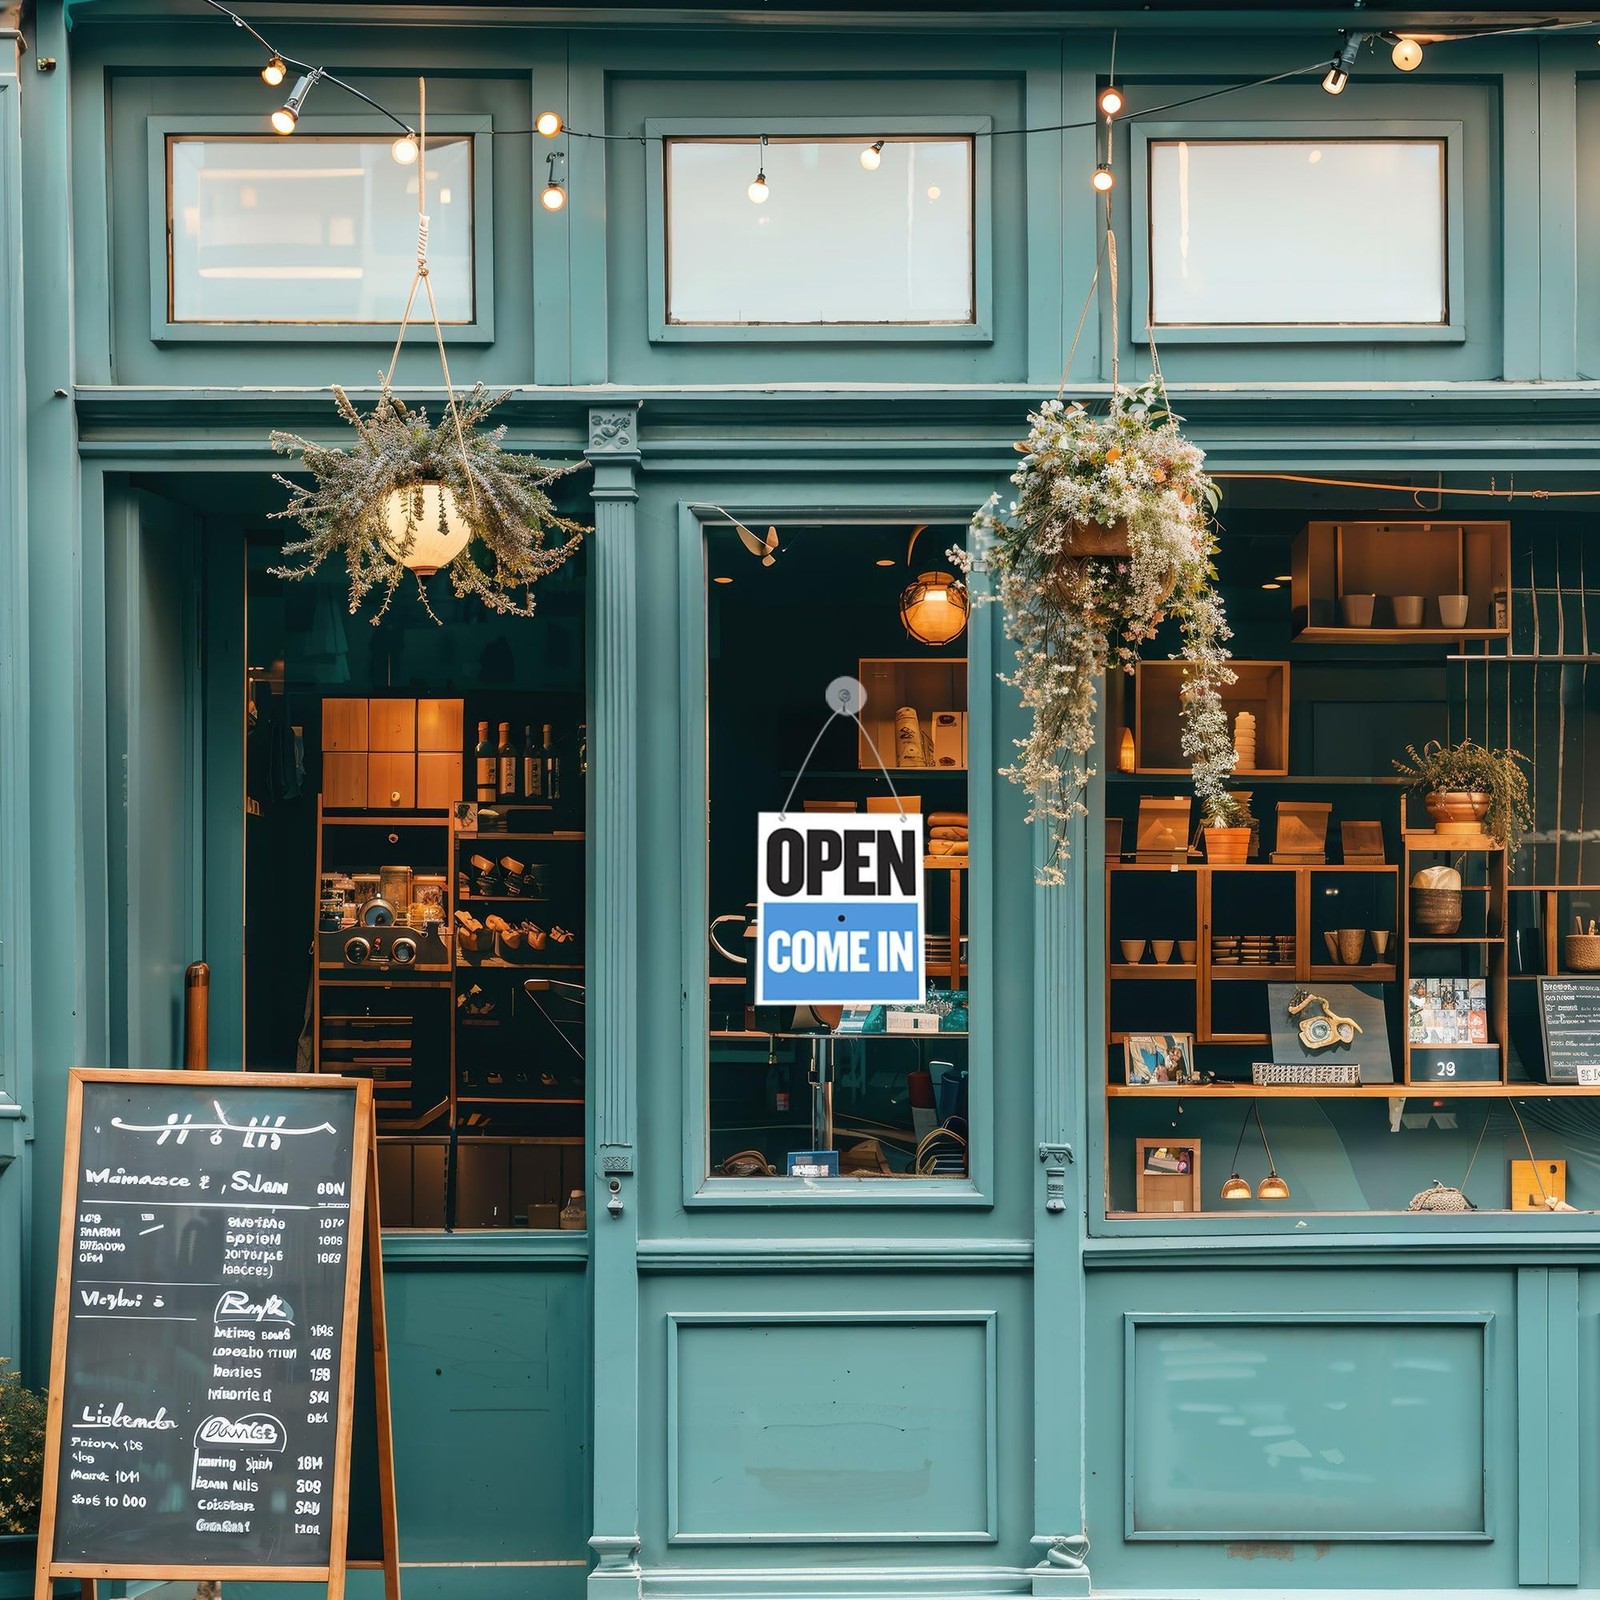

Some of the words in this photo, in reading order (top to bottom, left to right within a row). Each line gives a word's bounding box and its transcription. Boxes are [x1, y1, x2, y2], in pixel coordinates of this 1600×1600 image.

[767, 828, 916, 897] OPEN
[768, 930, 870, 973] COME
[878, 931, 912, 972] IN
